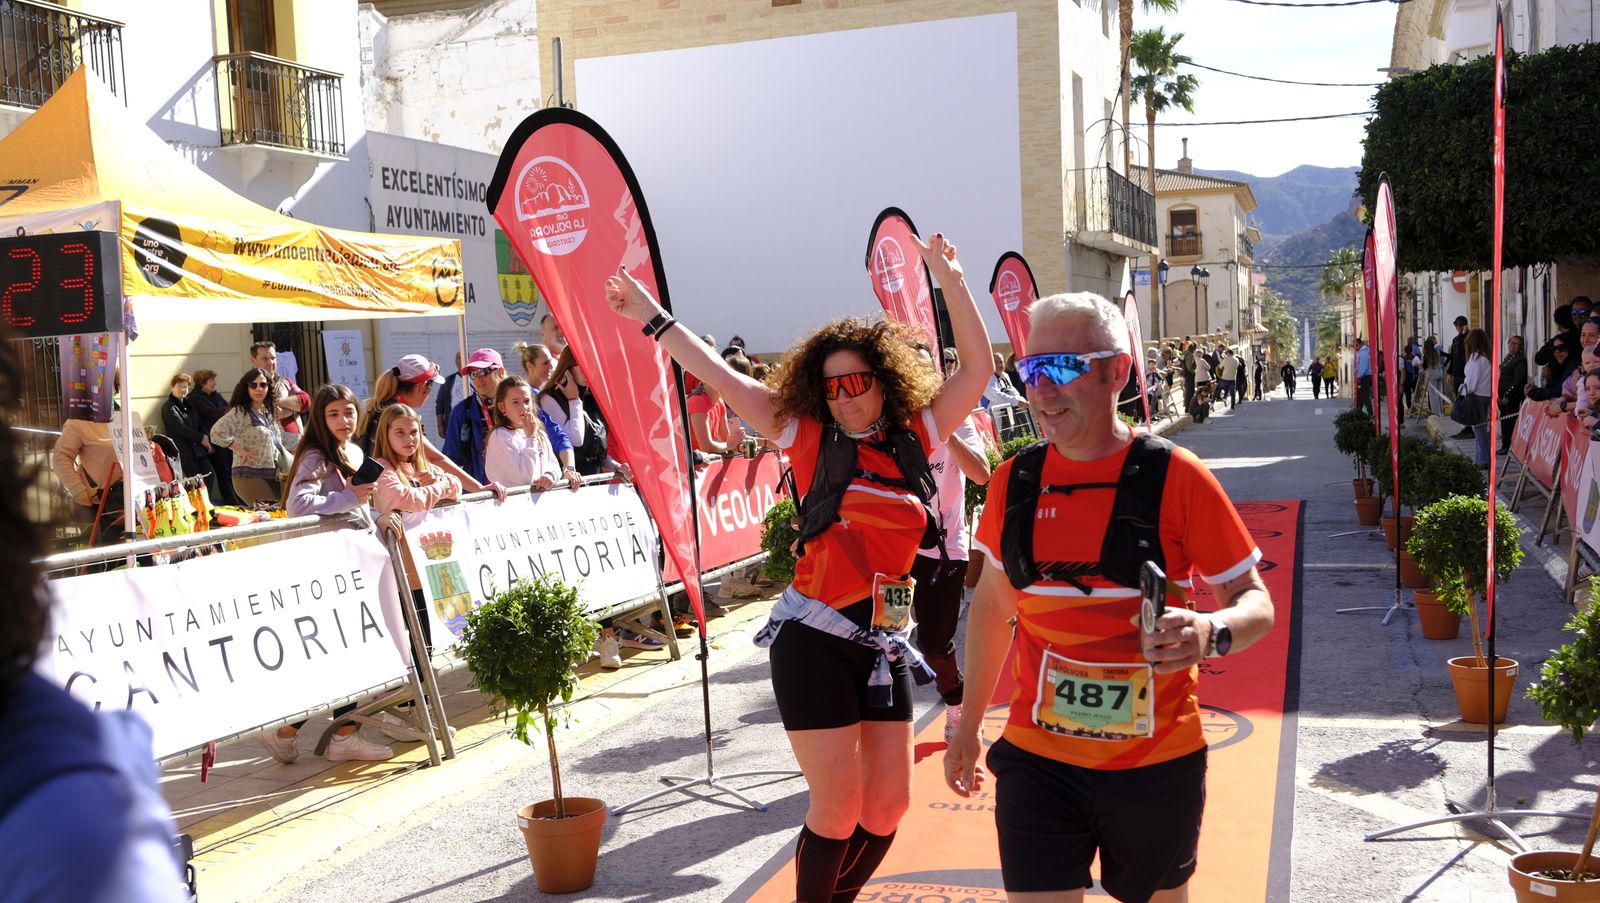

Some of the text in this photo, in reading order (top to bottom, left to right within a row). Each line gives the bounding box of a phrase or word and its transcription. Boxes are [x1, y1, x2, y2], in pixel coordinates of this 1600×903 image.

[382, 167, 486, 204] EXCELENTÍSIMO
[387, 205, 486, 237] AYUNTAMIENTO
[143, 239, 159, 248] uno
[2, 243, 95, 326] 23
[701, 484, 776, 537] VEOLIA
[474, 511, 636, 556] AYUNTAMIENTO DE
[478, 534, 647, 601] CANTORIA
[57, 569, 365, 657] AYUNTAMIENTO DE
[884, 587, 911, 607] 435
[64, 600, 384, 711] CANTORIA
[1056, 679, 1129, 710] 487
[883, 883, 998, 897] Cantoria
